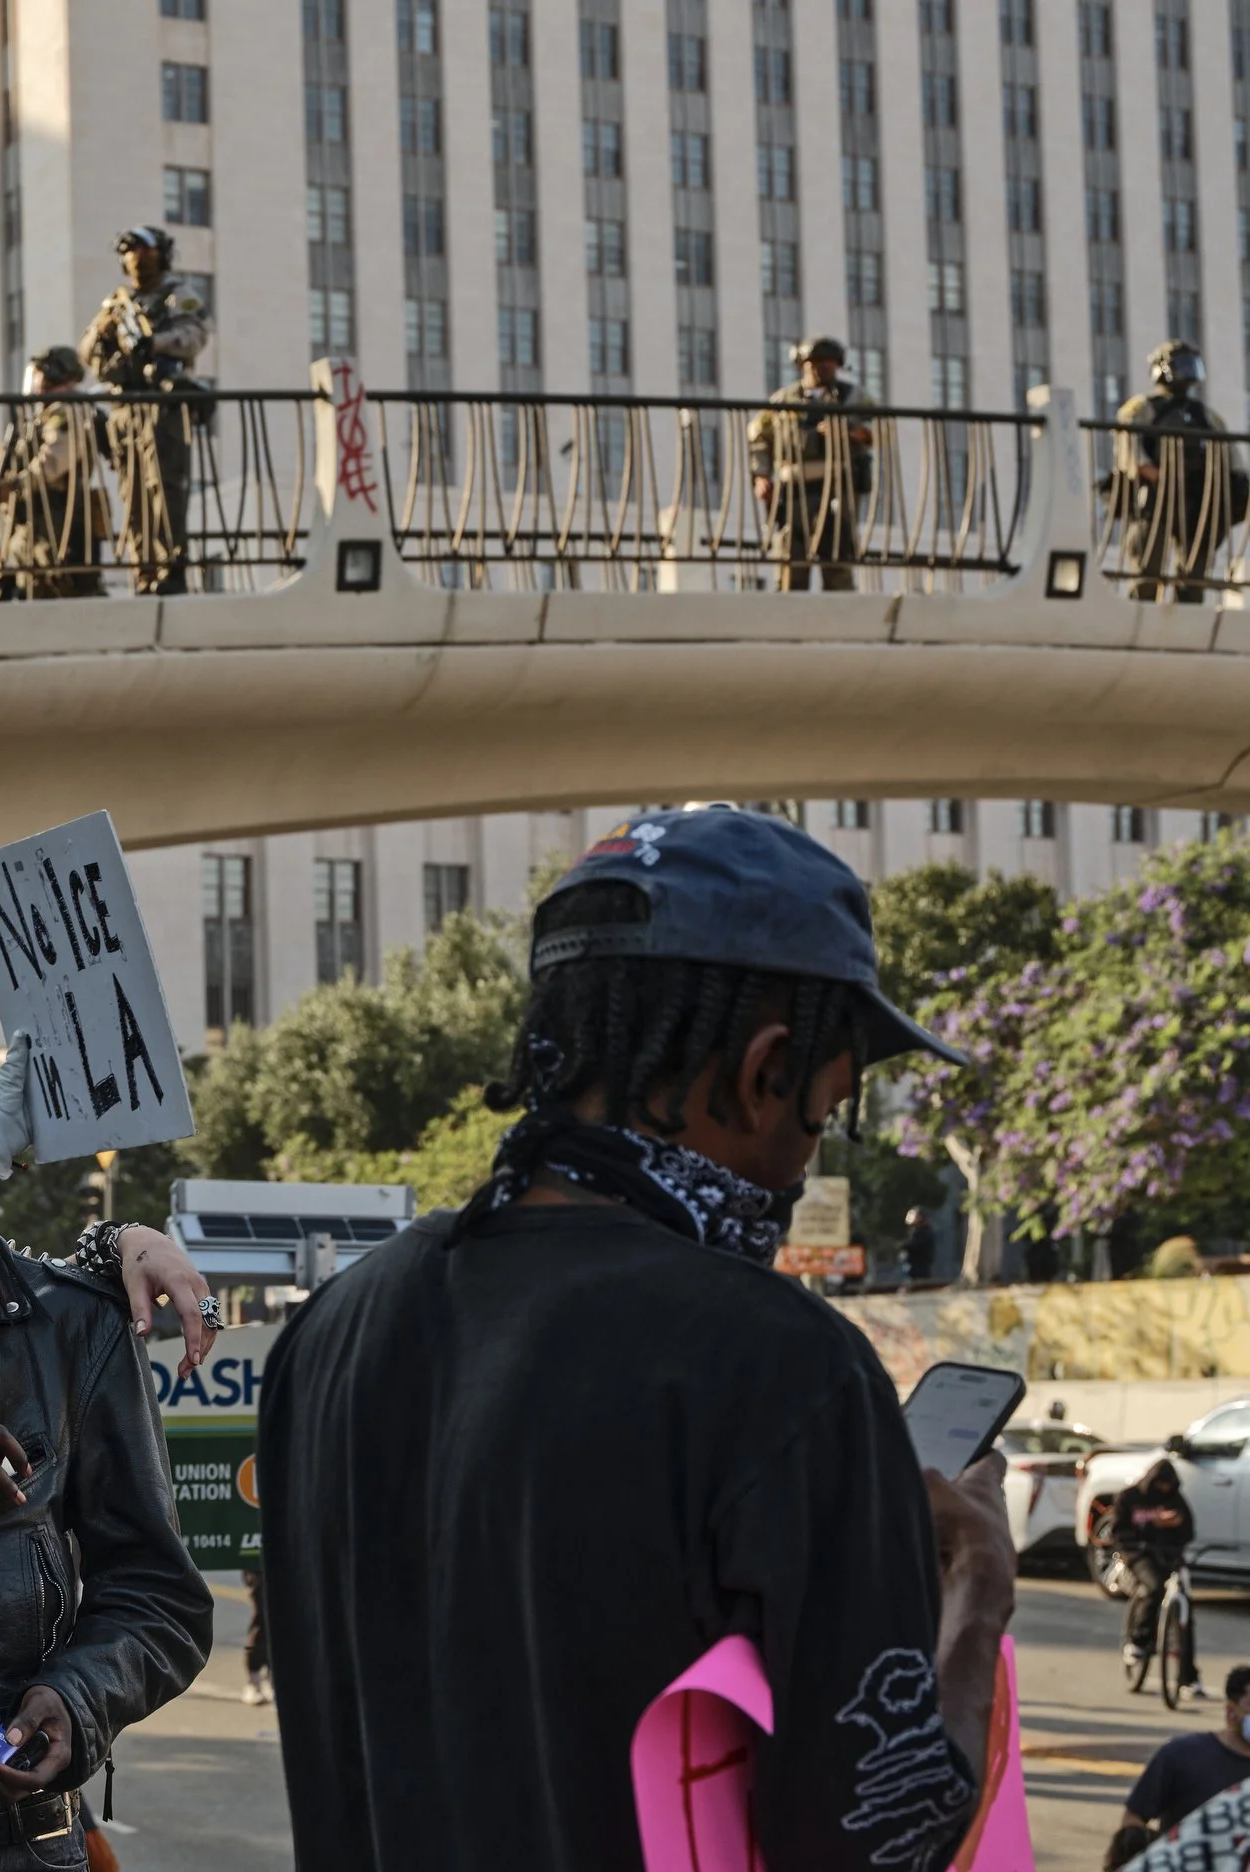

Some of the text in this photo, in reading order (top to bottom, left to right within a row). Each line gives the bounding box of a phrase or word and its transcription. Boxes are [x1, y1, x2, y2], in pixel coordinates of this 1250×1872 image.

[43, 857, 121, 971] ICE
[29, 972, 164, 1121] in LA
[175, 1463, 231, 1481] UNION
[172, 1483, 232, 1501] TATION
[193, 1534, 231, 1549] 10414
